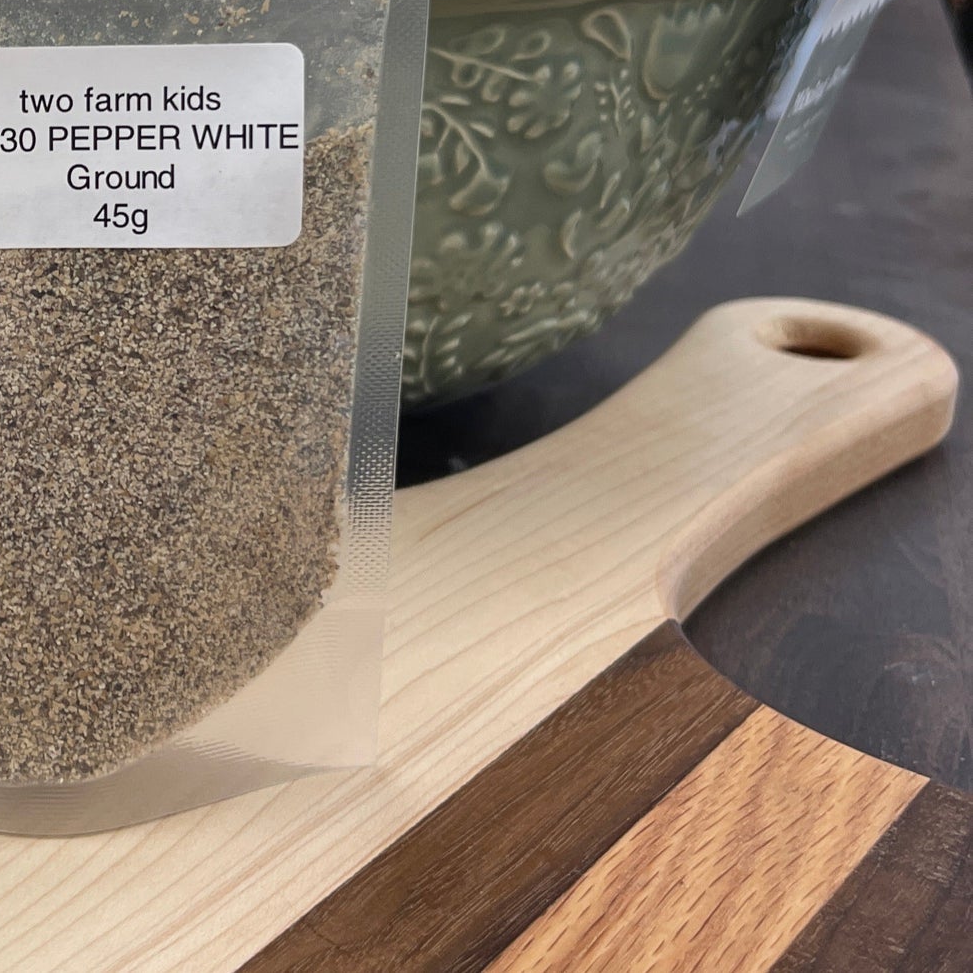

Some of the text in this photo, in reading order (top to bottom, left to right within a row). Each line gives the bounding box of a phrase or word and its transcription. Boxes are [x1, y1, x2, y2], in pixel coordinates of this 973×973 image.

[20, 86, 221, 113] two farm kids
[48, 125, 181, 151] PEPPER
[192, 123, 299, 150] WHITE
[67, 164, 175, 190] Ground
[93, 203, 149, 234] 45g
